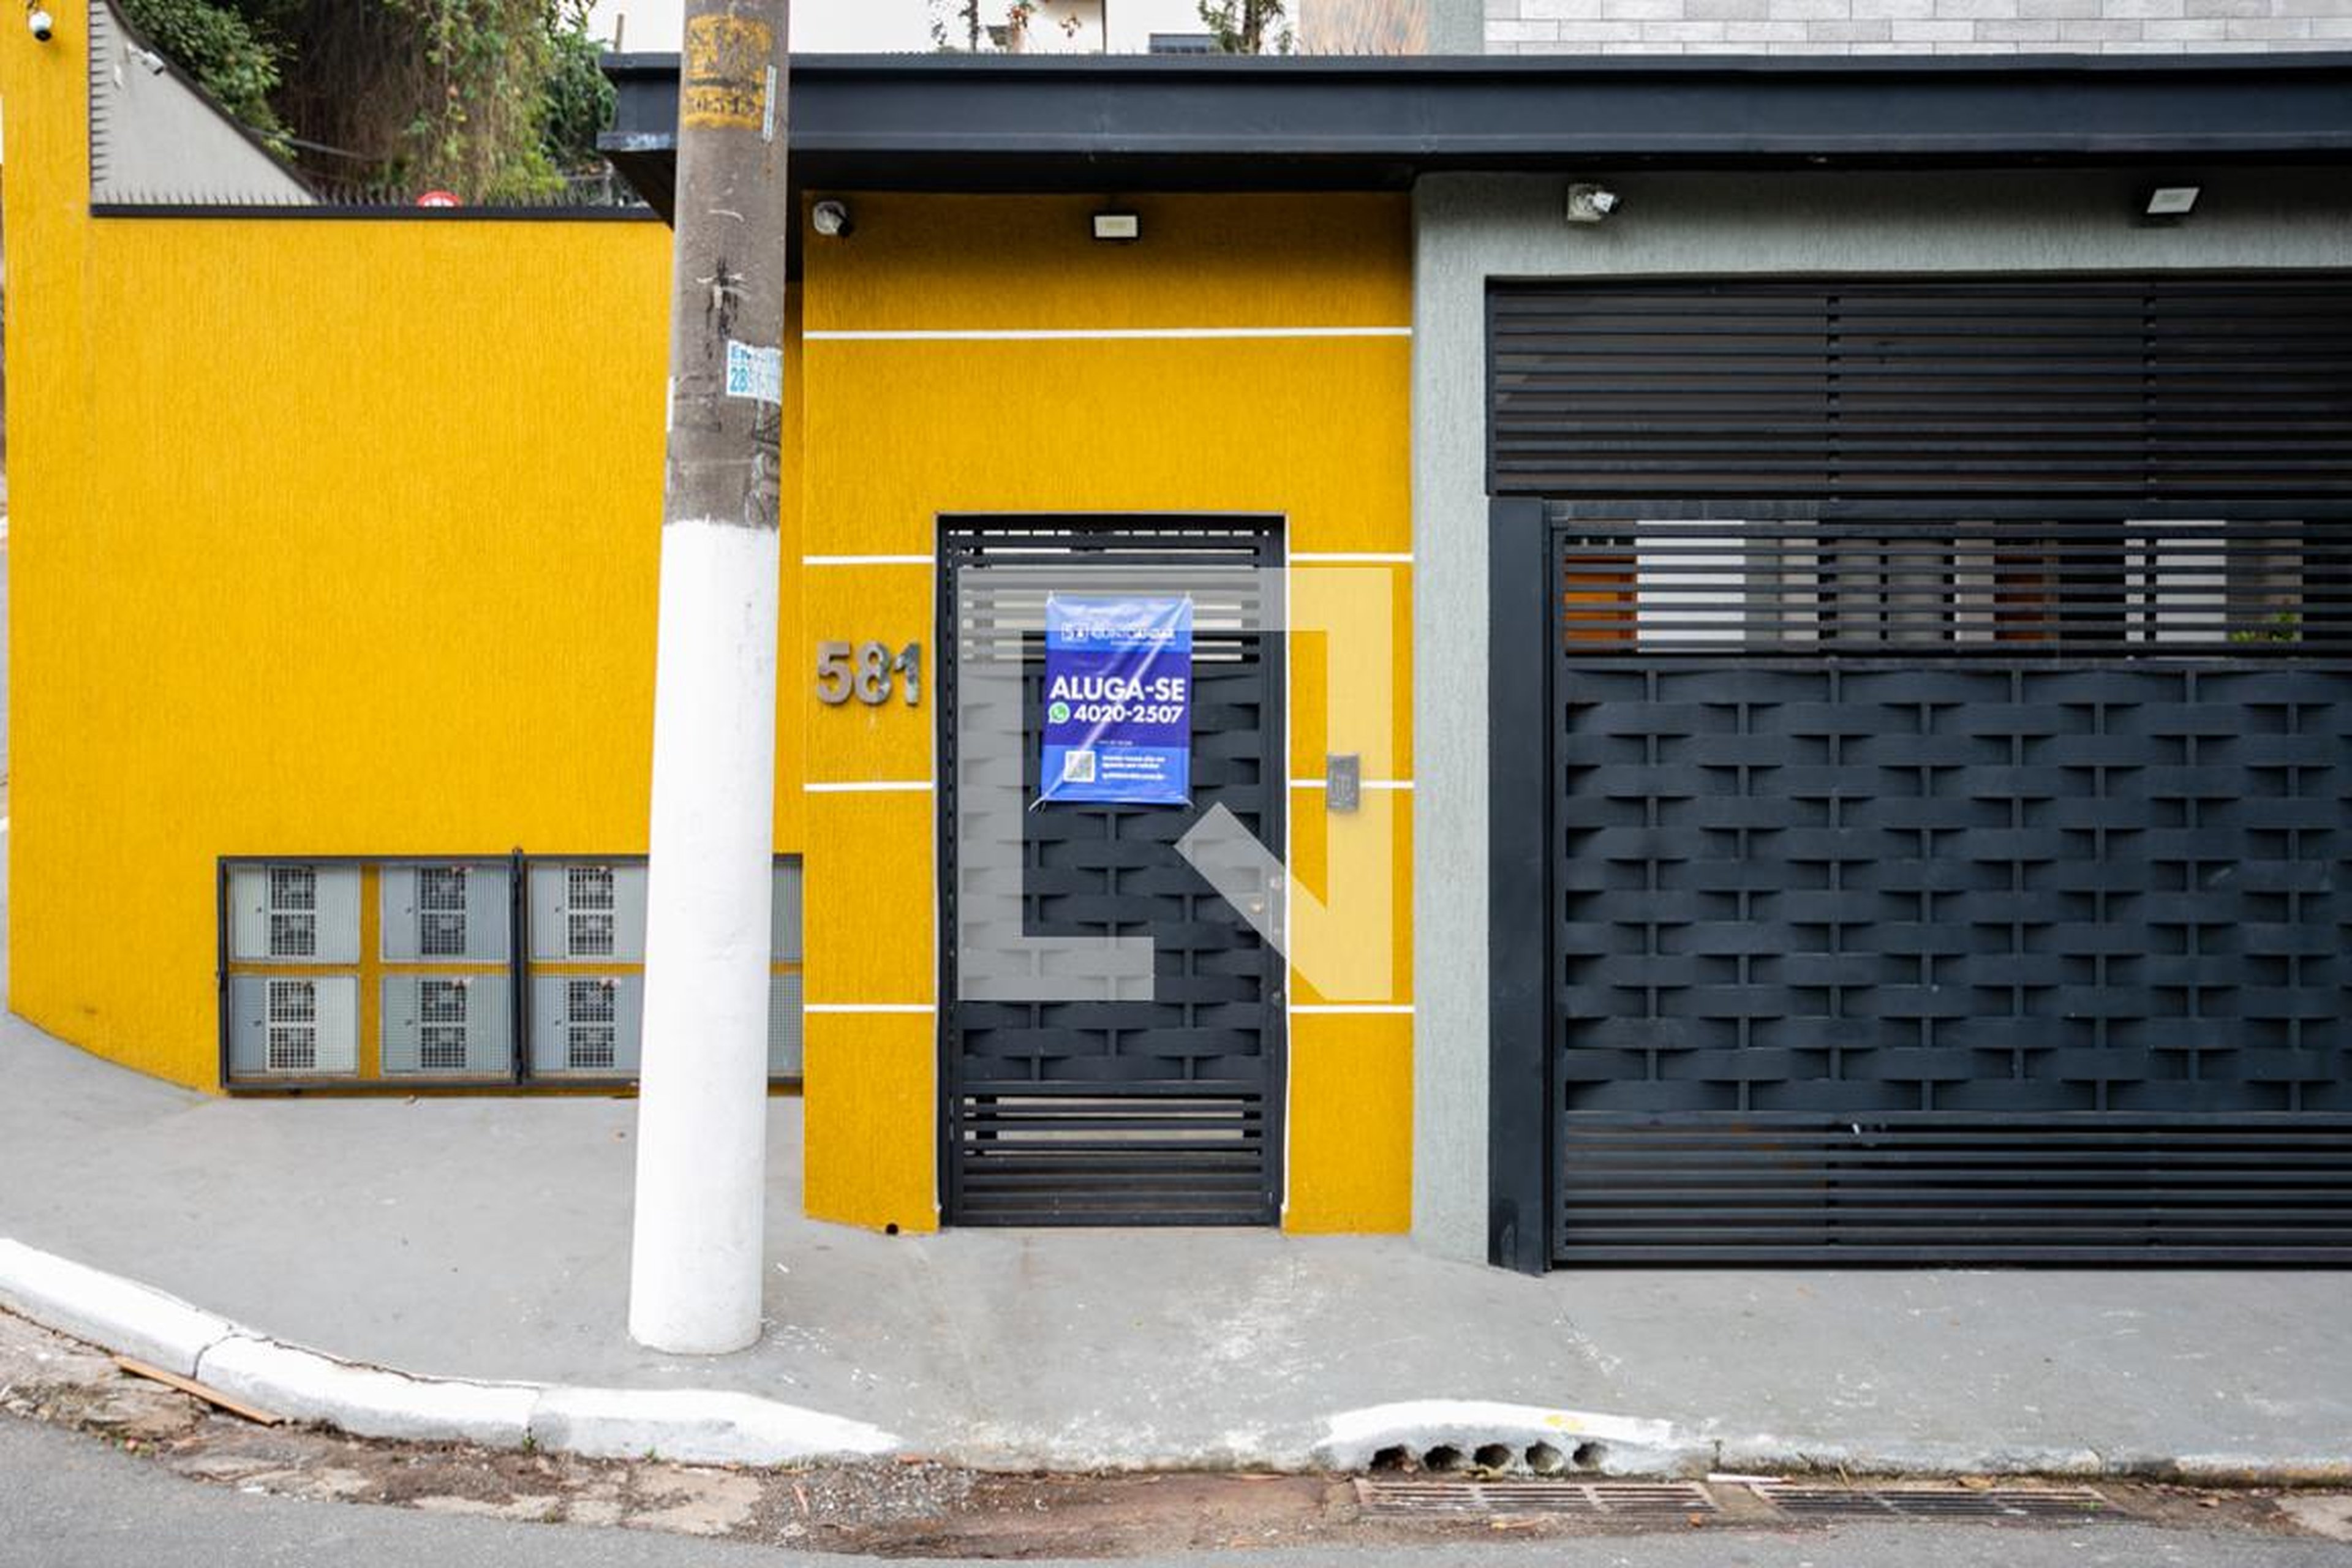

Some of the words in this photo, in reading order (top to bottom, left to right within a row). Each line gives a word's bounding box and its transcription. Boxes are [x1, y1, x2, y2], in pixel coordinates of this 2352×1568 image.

[816, 639, 921, 704] 581
[1050, 677, 1186, 702] ALUGA-SE
[1074, 704, 1184, 723] 4020-2507
